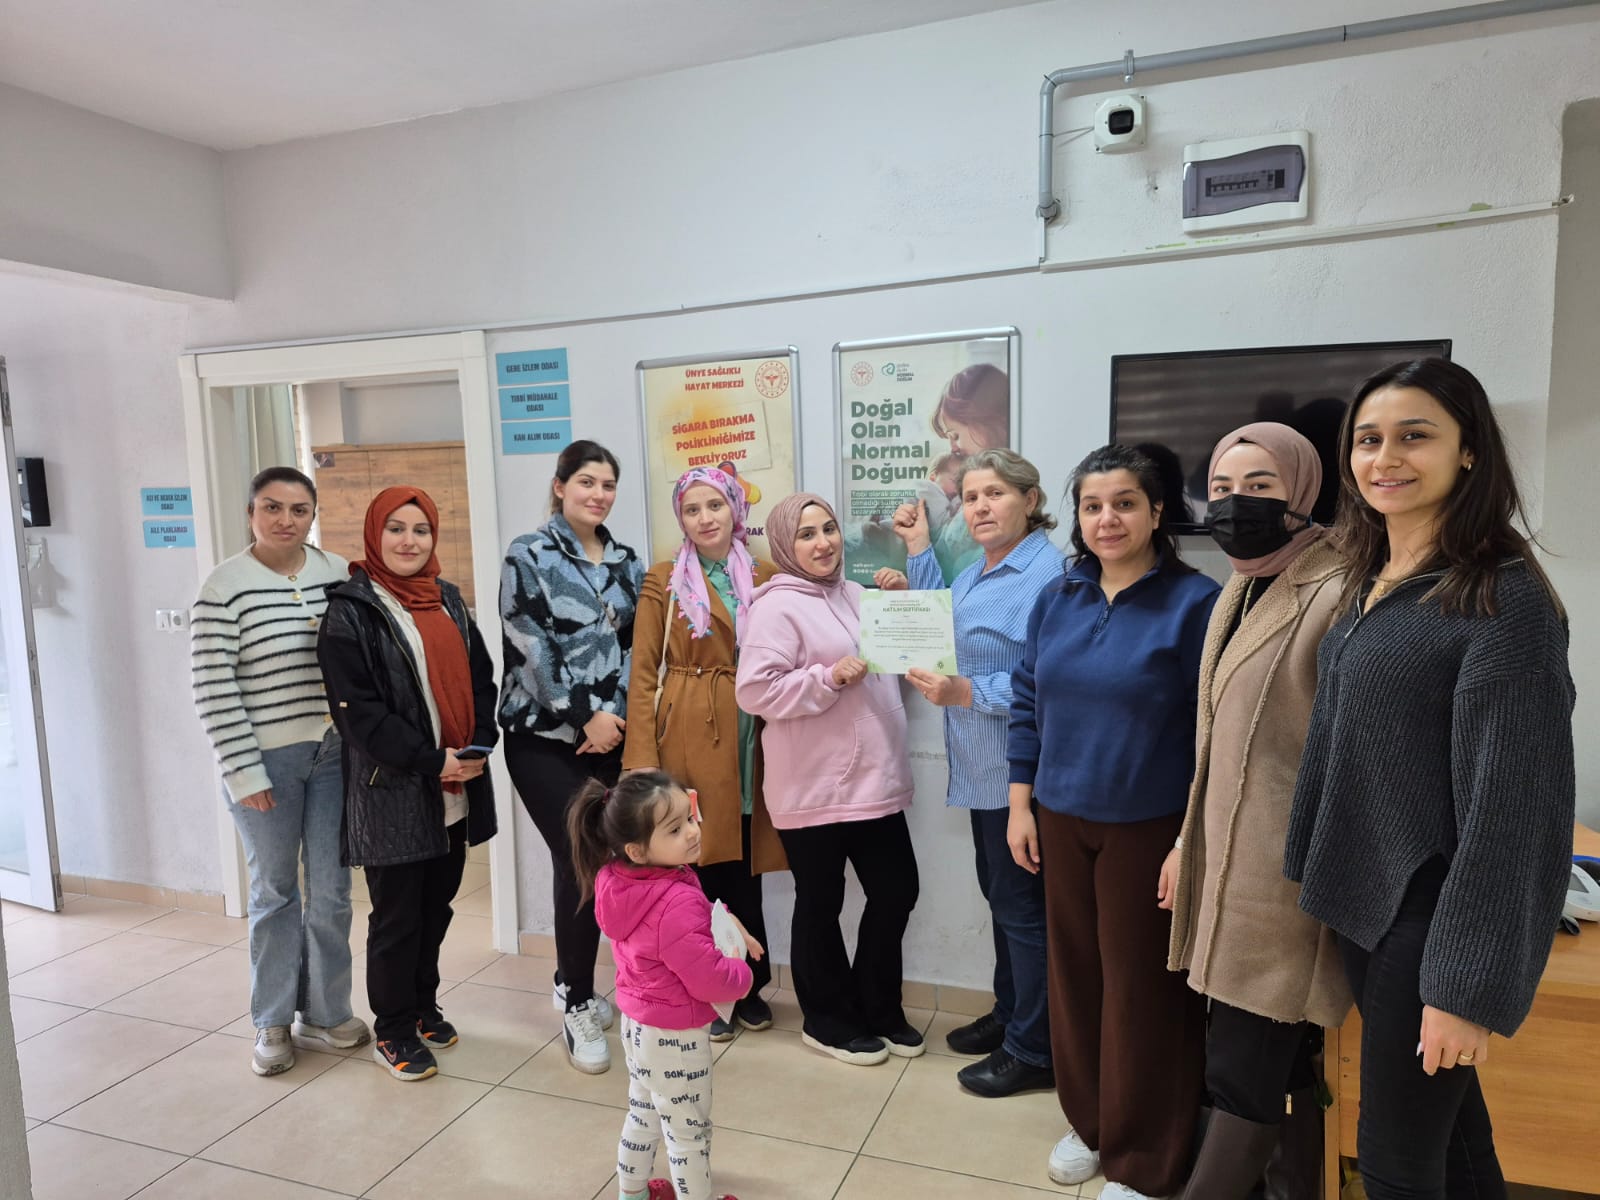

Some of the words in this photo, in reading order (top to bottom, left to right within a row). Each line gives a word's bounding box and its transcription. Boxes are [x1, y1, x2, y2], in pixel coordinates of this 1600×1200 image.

[506, 364, 521, 373] GEBE
[522, 362, 540, 372] İZLEM
[541, 361, 559, 371] ODASI
[685, 367, 706, 378] ÜNYE
[707, 365, 741, 376] SAĞLIKLI
[685, 381, 710, 391] HAYAT
[711, 379, 744, 390] MERKEZİ
[526, 392, 558, 402] MÜDAHALE
[526, 403, 544, 413] ODASI
[851, 397, 913, 421] Doğal
[672, 421, 709, 435] SİGARA
[709, 413, 756, 430] BIRAKMA
[851, 421, 901, 439] Olan
[513, 433, 526, 442] KAN
[527, 432, 541, 441] ALIM
[542, 431, 561, 441] ODASI
[676, 430, 756, 452] POLİKLİNİĞİMİZE
[851, 440, 930, 460] Normal
[688, 449, 747, 467] BEKLİYORUZ
[851, 462, 929, 485] Doğum
[746, 527, 764, 536] RAK
